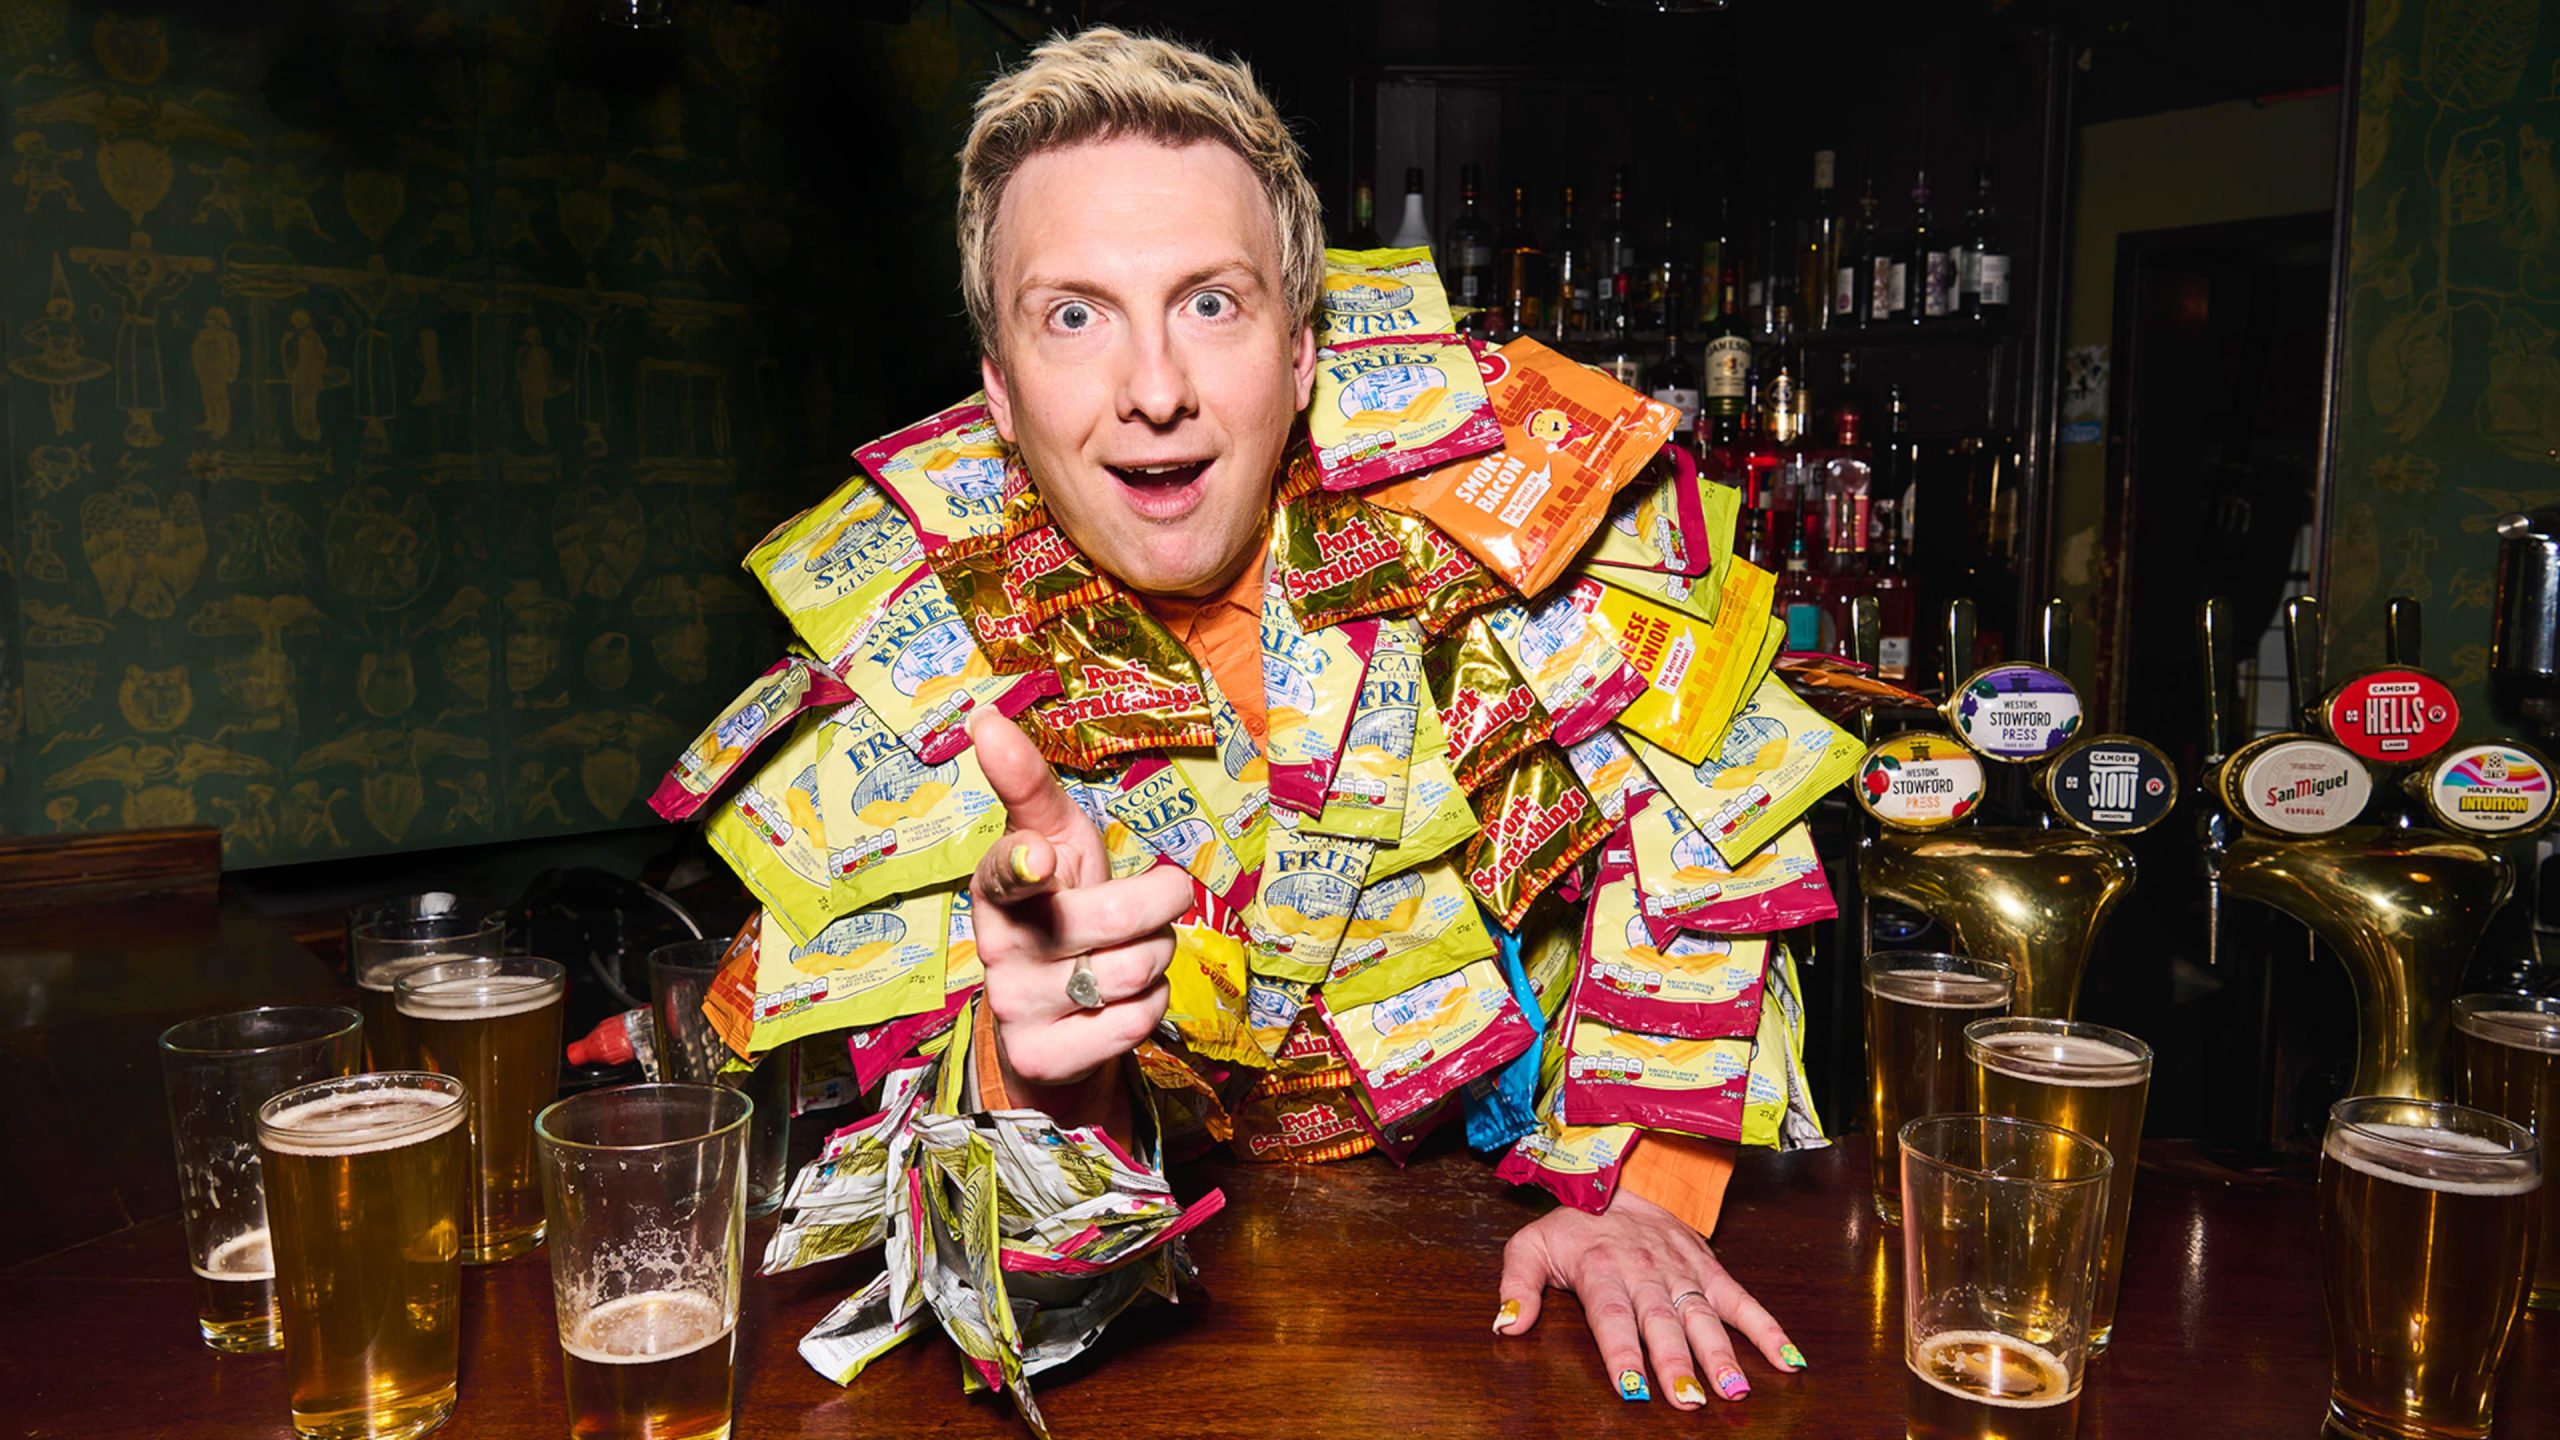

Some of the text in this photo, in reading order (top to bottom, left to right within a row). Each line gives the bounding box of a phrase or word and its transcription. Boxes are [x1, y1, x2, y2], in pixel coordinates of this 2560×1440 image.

[1328, 353, 1438, 385] FRIES
[1455, 451, 1506, 503] SMOKY
[1475, 456, 1527, 514] BACON
[814, 514, 909, 590] FRIES
[1313, 517, 1376, 562] Pork
[1286, 533, 1400, 600] Scratchin
[866, 578, 939, 647] BACON
[1261, 624, 1333, 675] RIES
[1618, 611, 1649, 660] EESE
[1635, 617, 1671, 673] ONION
[1082, 658, 1150, 690] Pork
[1368, 657, 1422, 674] SCA
[1359, 681, 1422, 710] FRI
[1439, 684, 1481, 730] ork
[2004, 700, 2038, 709] WESTONS
[2372, 685, 2415, 693] CAMDEN
[1446, 683, 1536, 762] atchings
[1990, 712, 2051, 726] STOWFORD
[2002, 728, 2038, 741] PRESS
[2365, 697, 2425, 735] HELLS
[1905, 768, 1939, 777] WESTONS
[2093, 754, 2135, 762] CAMDEN
[1114, 772, 1174, 816] ACON
[1892, 779, 1954, 795] STOWFORD
[1905, 795, 1941, 808] PRESS
[2088, 765, 2139, 809] STOUT
[2459, 796, 2528, 813] INTUITION
[1127, 788, 1198, 833] RIES
[1485, 794, 1538, 845] Pork
[1470, 786, 1588, 898] Scratchings
[1250, 1117, 1365, 1155] Scratching
[1278, 1104, 1338, 1133] Pork
